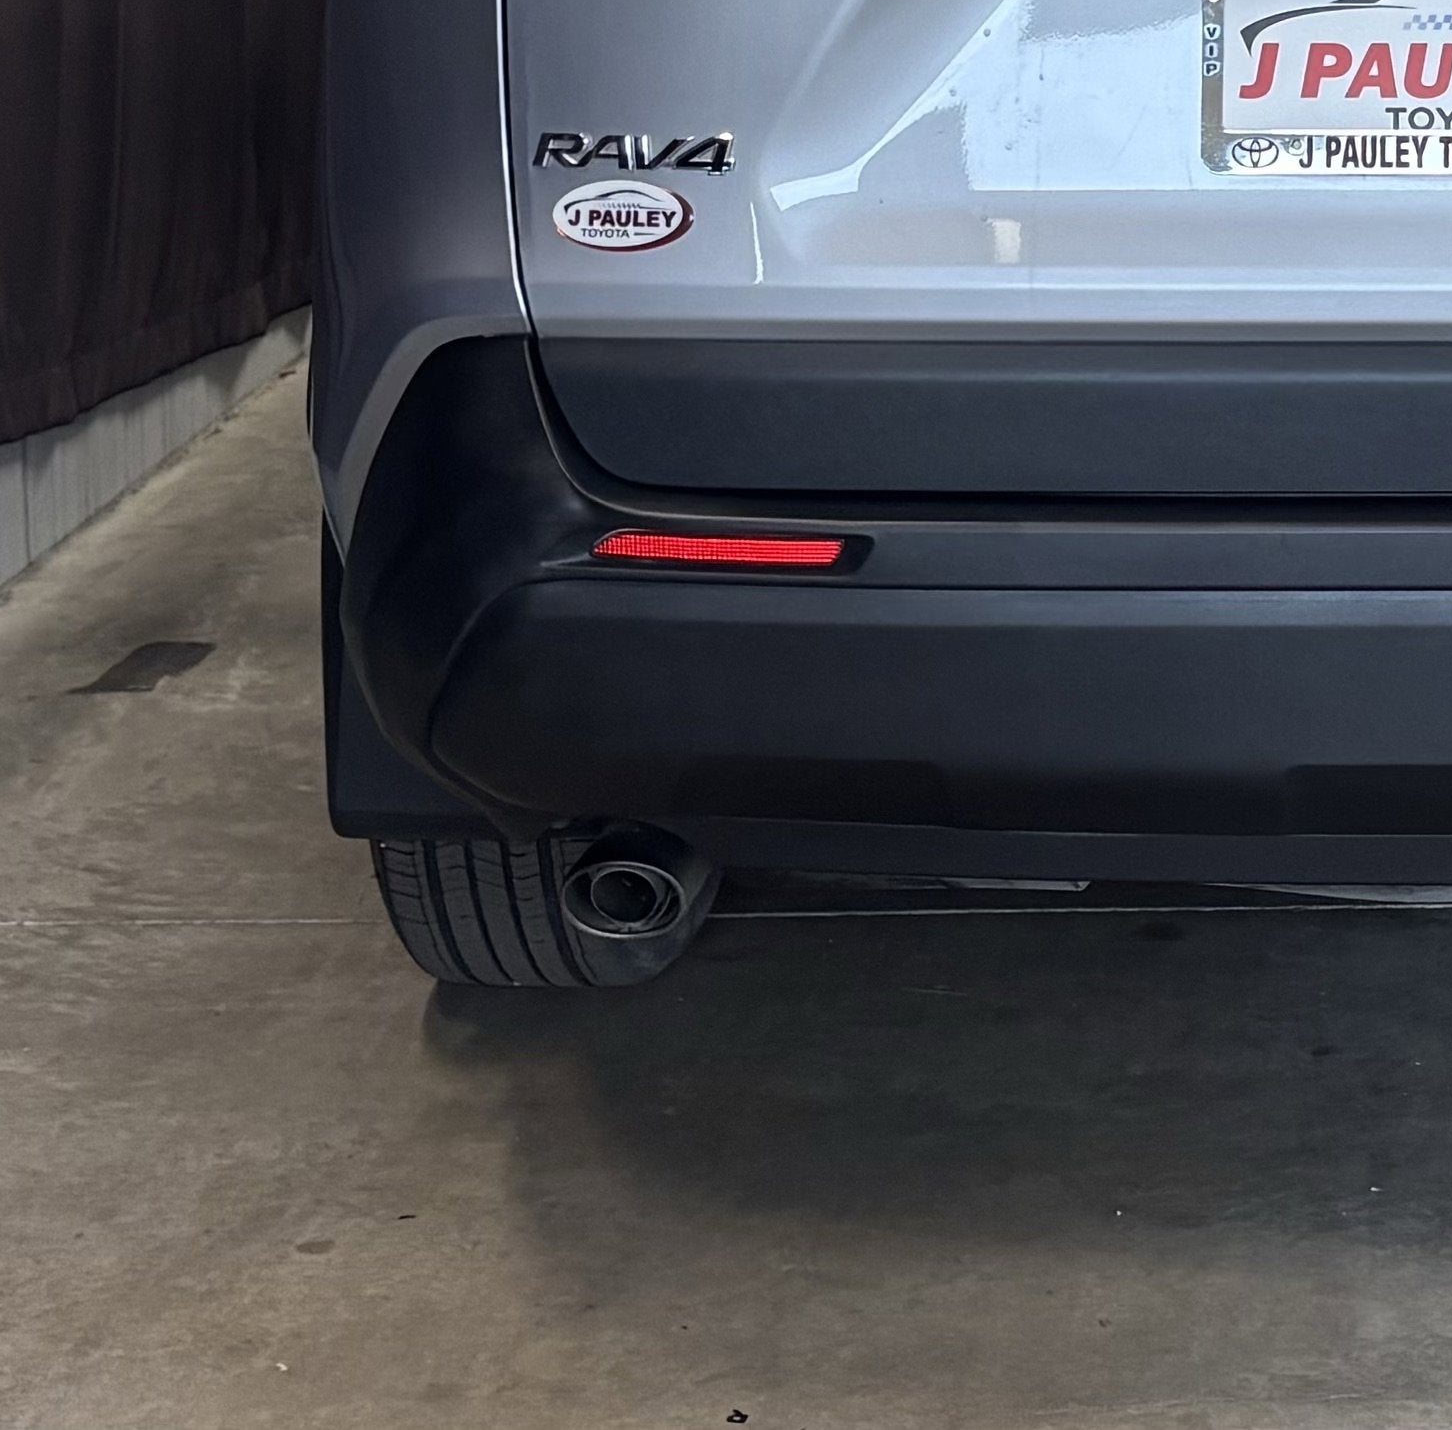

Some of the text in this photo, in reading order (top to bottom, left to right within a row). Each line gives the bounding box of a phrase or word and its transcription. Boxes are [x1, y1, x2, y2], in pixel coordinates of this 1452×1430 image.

[1238, 42, 1280, 100] J
[532, 132, 737, 176] RAV4
[1299, 137, 1314, 169] J
[1325, 136, 1427, 168] PAULEY
[567, 209, 677, 228] J PAULEY
[580, 228, 630, 239] TOYOTA
